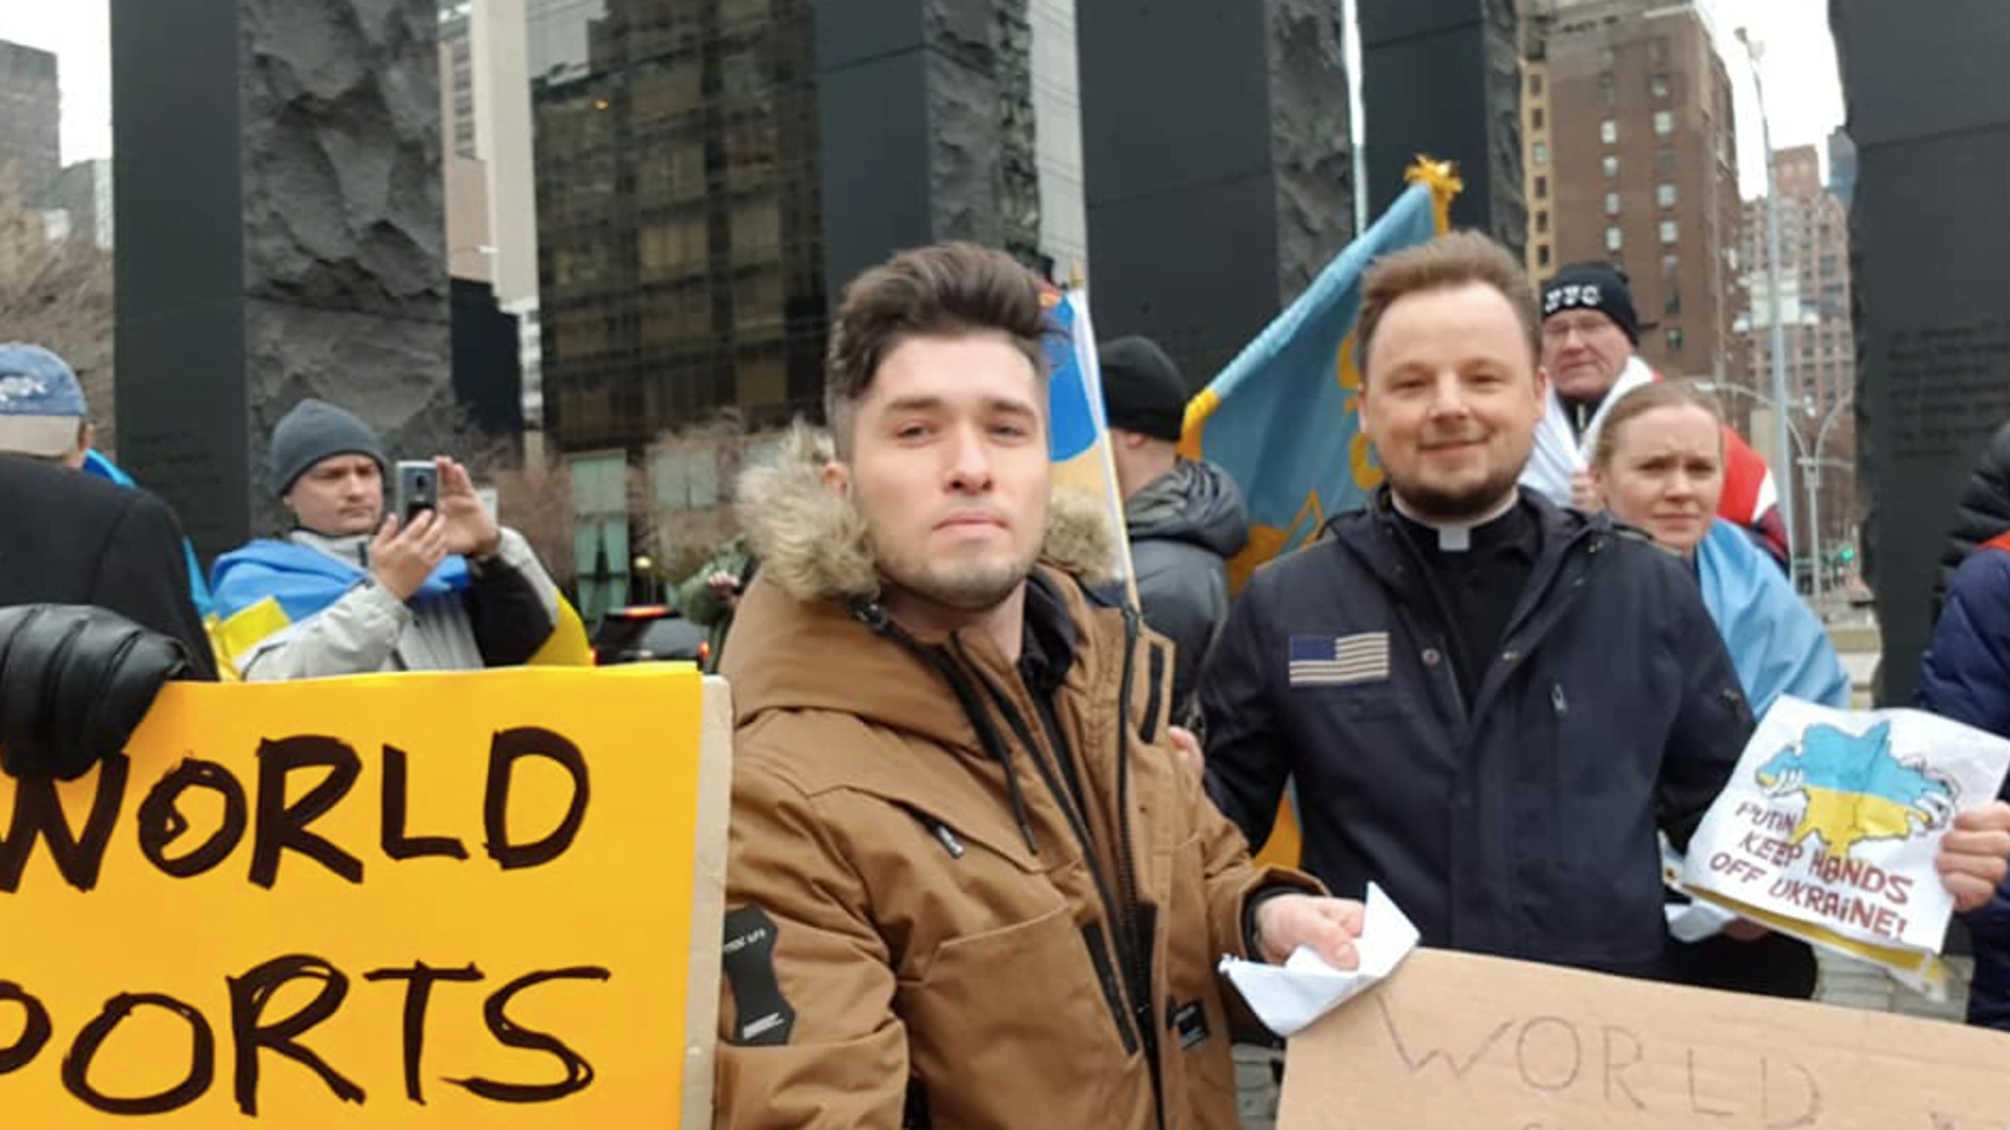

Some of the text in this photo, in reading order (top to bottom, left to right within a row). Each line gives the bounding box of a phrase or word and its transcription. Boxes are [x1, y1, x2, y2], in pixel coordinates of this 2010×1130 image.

[0, 726, 590, 892] WORLD
[1709, 851, 1767, 883] OFF
[1738, 830, 1914, 906] KEEP HANDS
[1374, 990, 1819, 1130] WORLD
